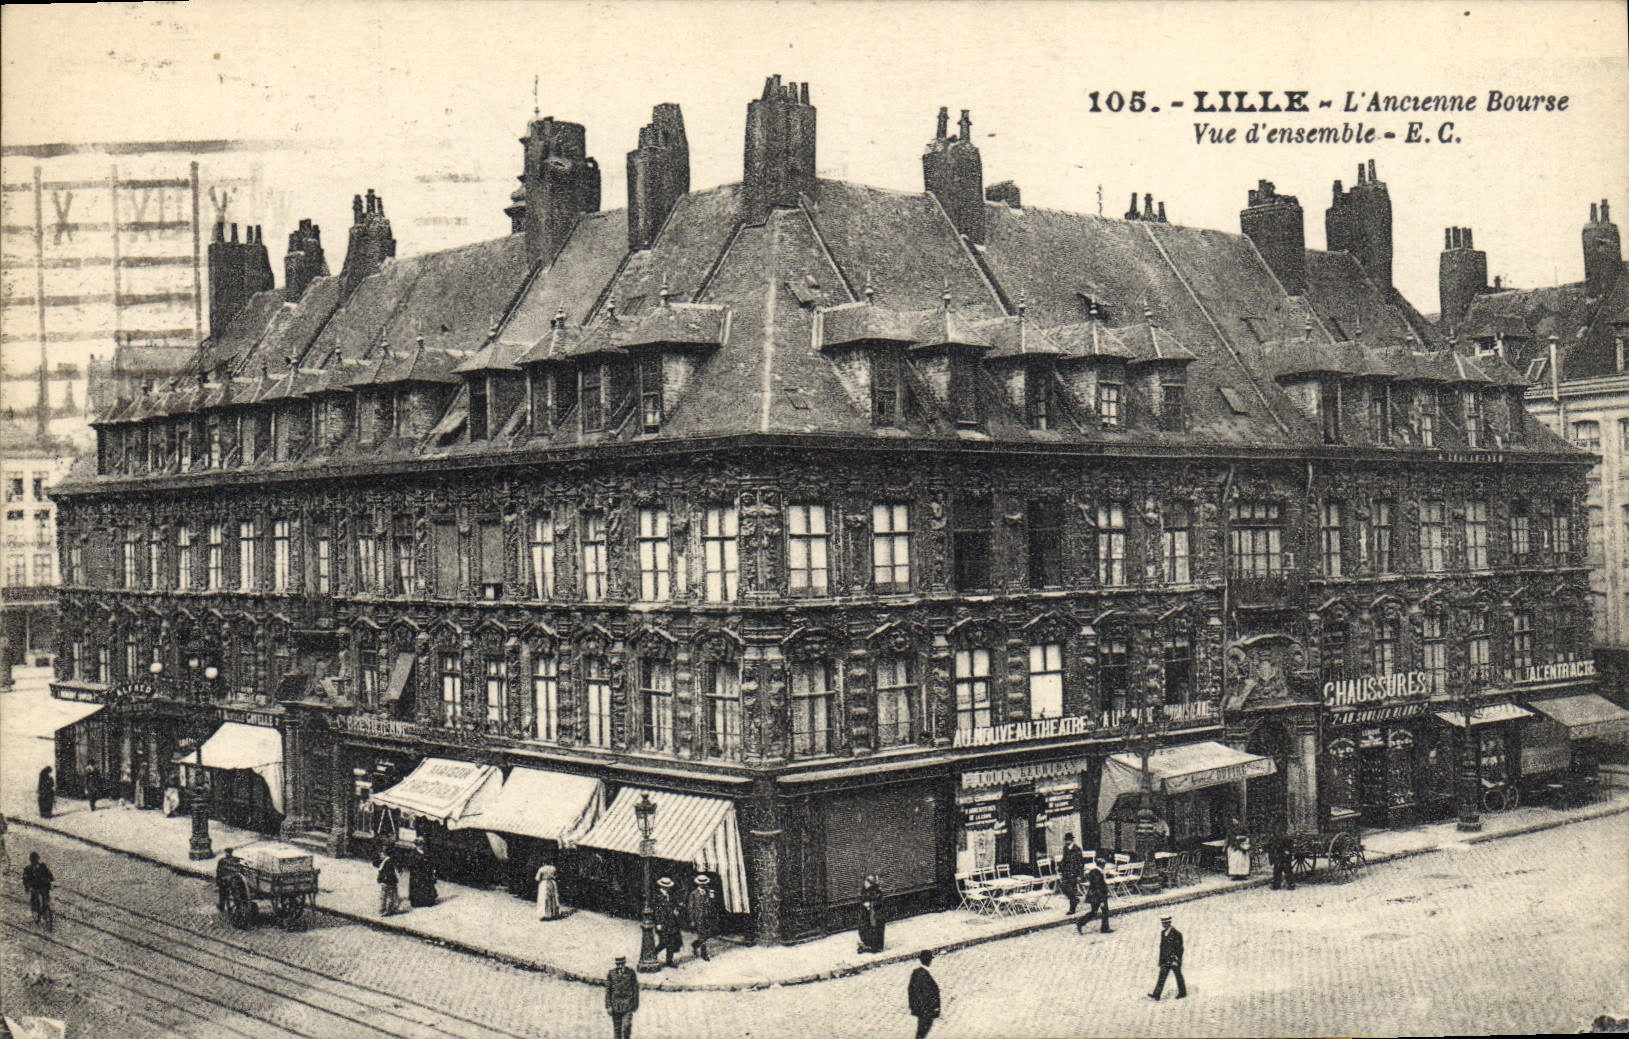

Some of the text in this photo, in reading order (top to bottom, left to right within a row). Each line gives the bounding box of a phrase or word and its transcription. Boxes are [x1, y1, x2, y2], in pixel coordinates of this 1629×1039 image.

[1323, 671, 1426, 707] CHAUSSURES
[952, 716, 1089, 749] AU NOUVEAU THEATRE
